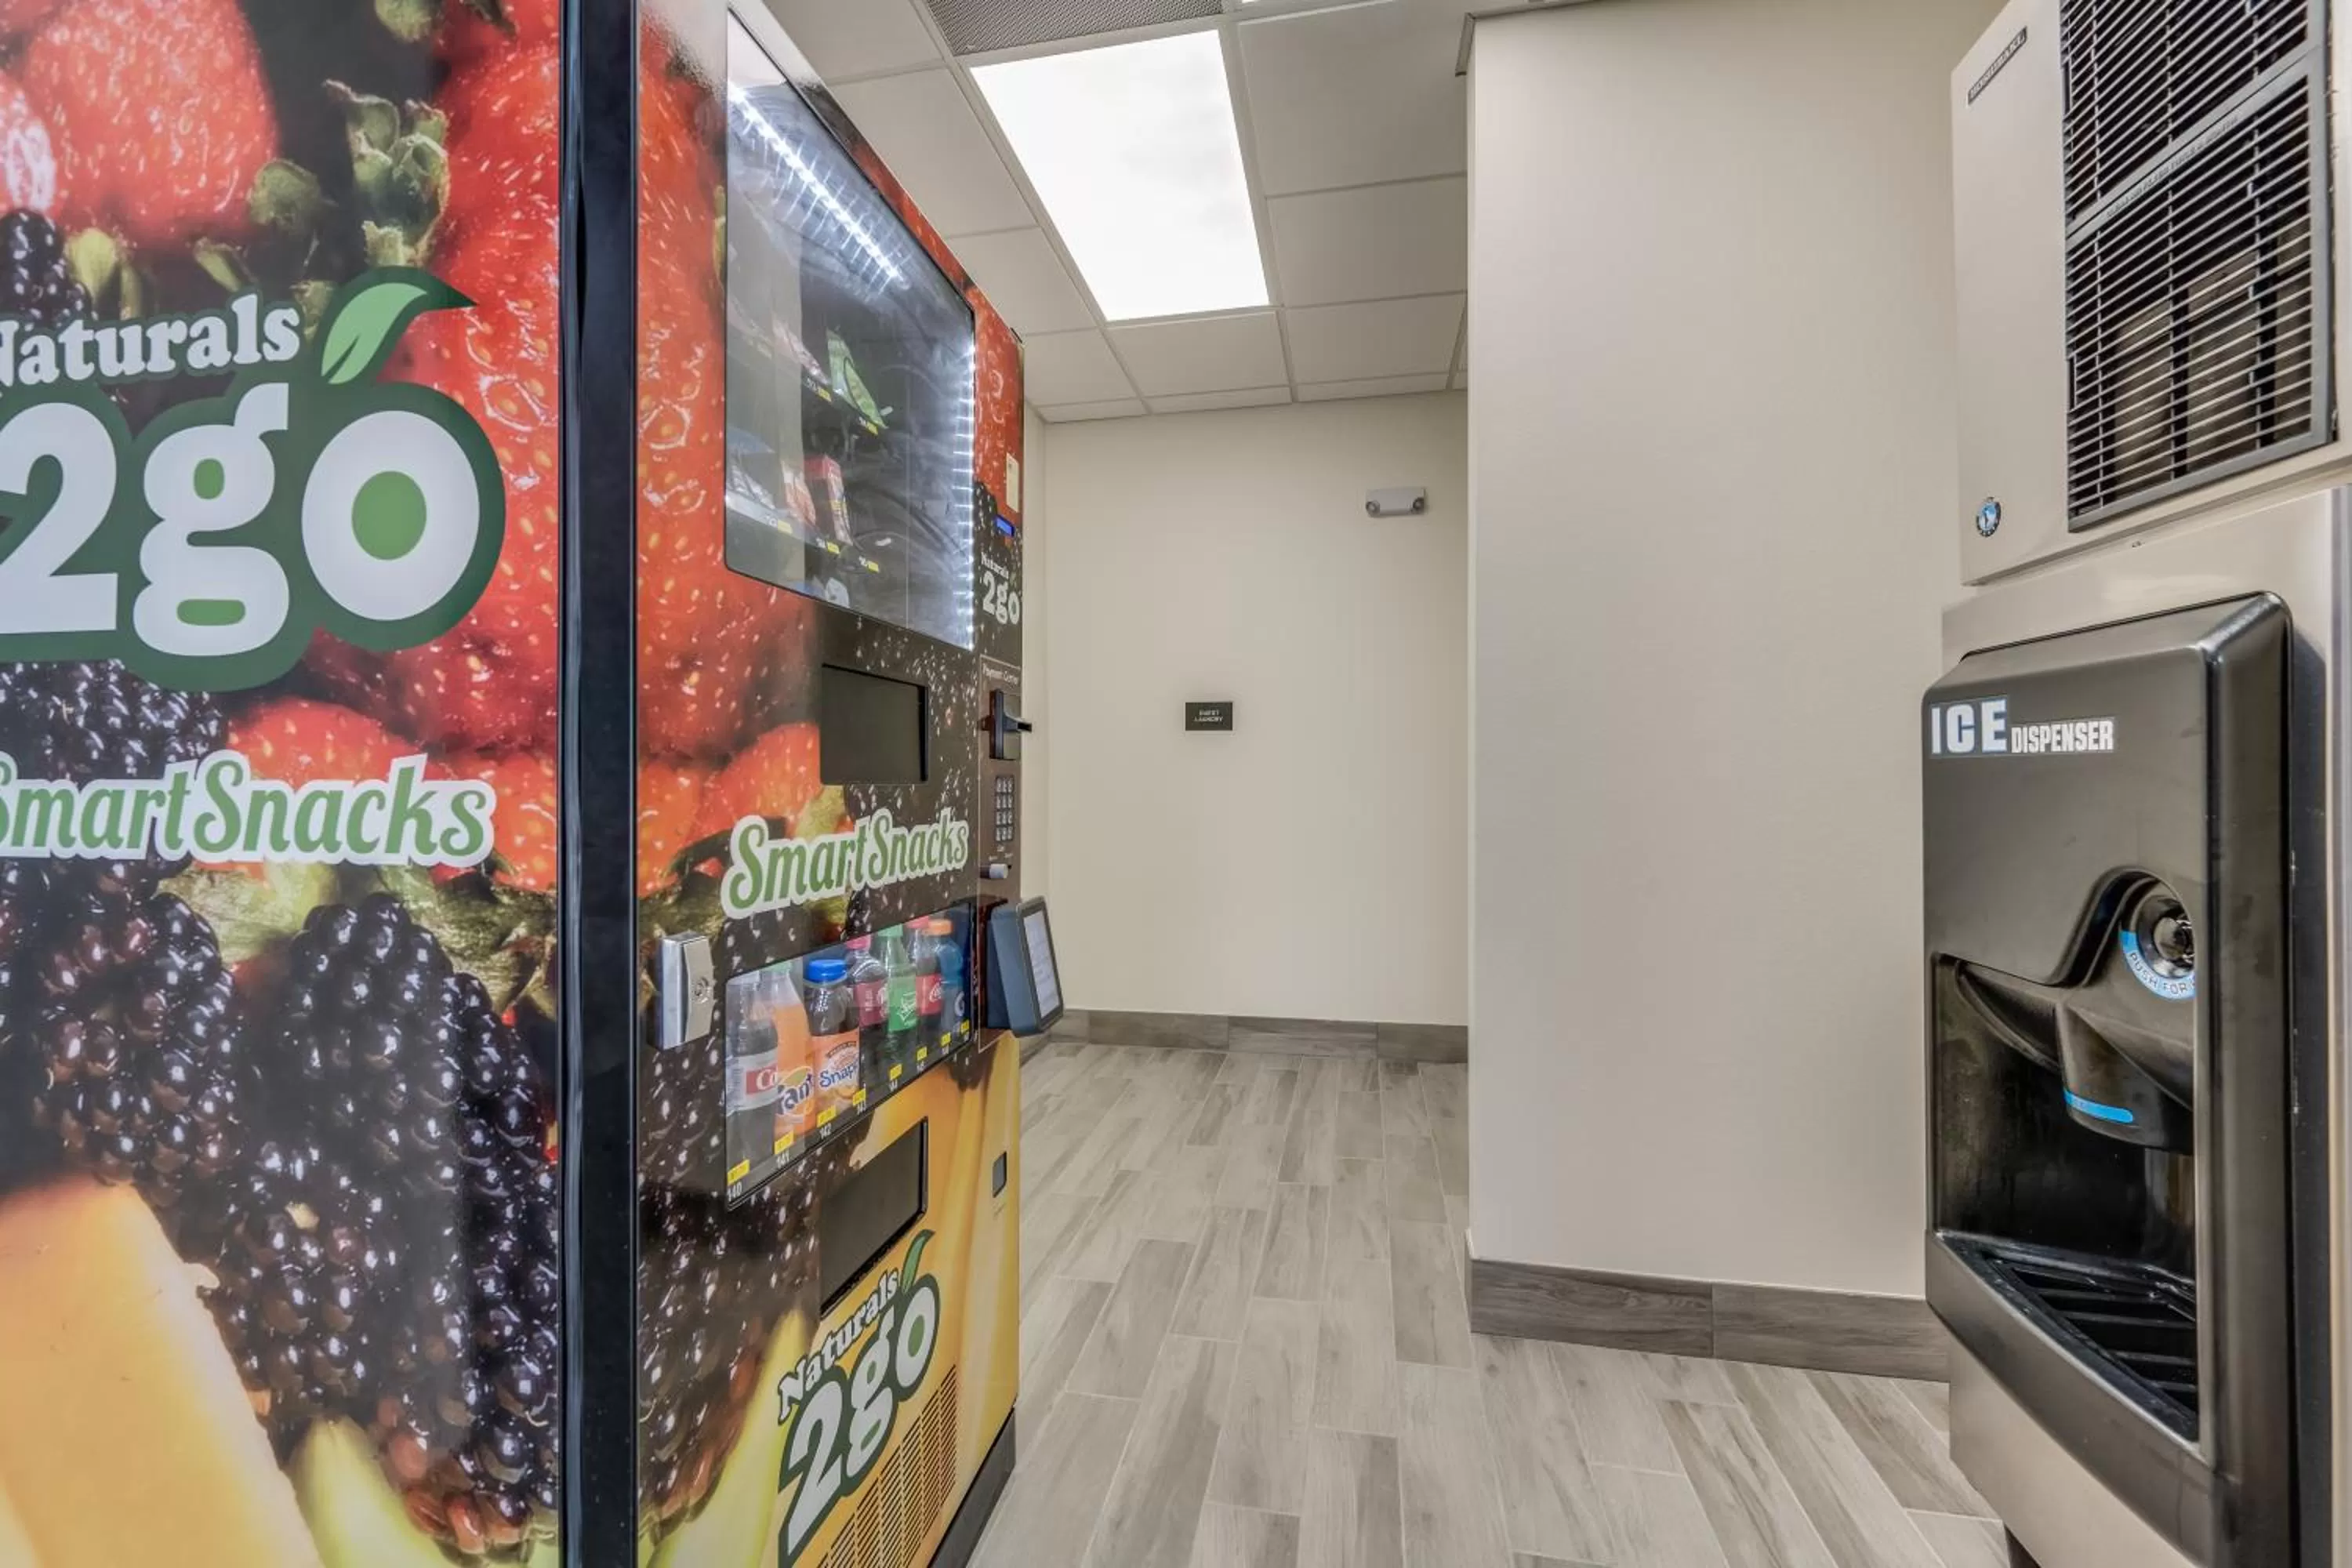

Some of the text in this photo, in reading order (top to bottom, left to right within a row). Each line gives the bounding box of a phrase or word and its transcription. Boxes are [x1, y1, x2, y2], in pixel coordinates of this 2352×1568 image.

[0, 382, 480, 656] 2go
[982, 570, 1019, 625] 2go
[1931, 699, 2114, 754] ICE DISPENSER
[0, 754, 492, 863] martSnacks
[726, 811, 969, 914] SmartSnacks
[727, 1181, 742, 1202] 140
[778, 1269, 899, 1423] Naturals
[788, 1286, 935, 1556] 2go
